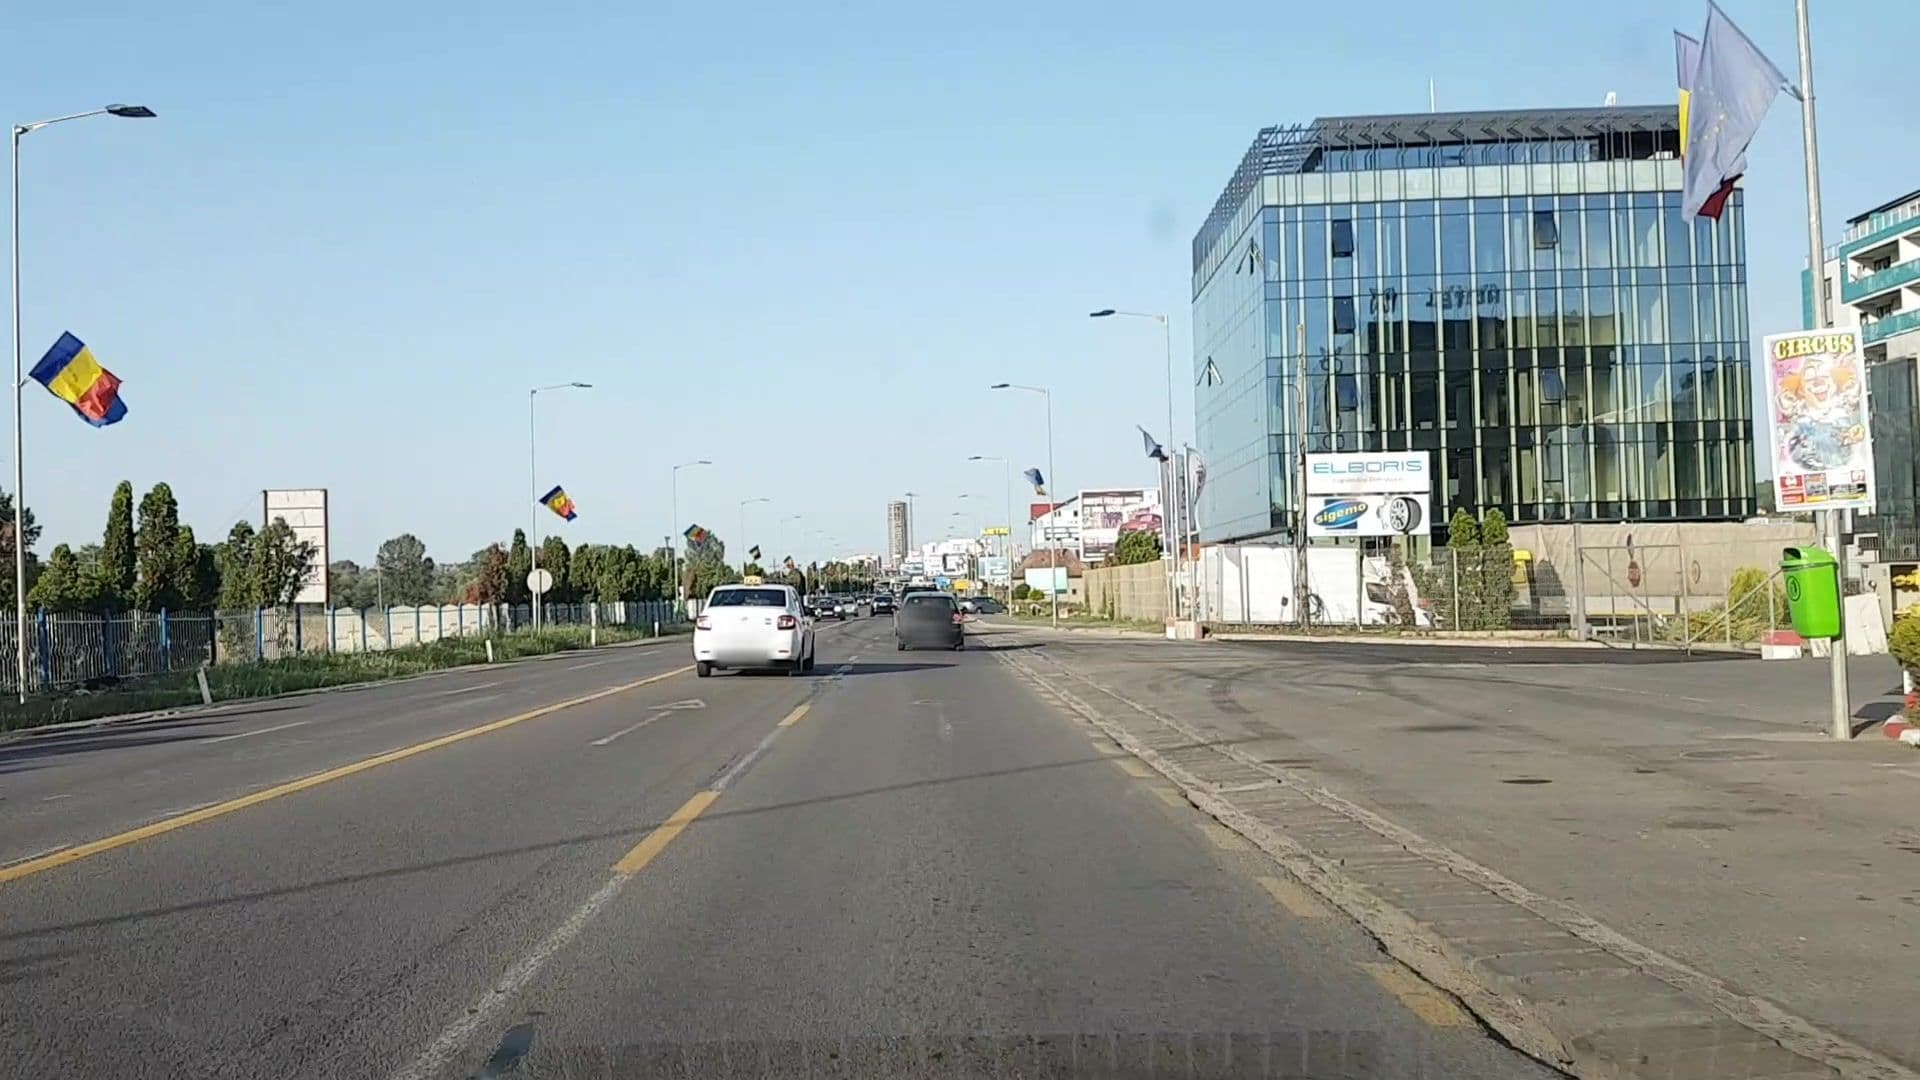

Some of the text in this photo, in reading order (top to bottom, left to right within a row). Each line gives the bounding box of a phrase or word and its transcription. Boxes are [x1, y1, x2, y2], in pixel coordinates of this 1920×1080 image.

[1775, 334, 1854, 360] CIRCUS
[1313, 460, 1422, 474] ELBORIS
[1315, 503, 1367, 524] sigemo
